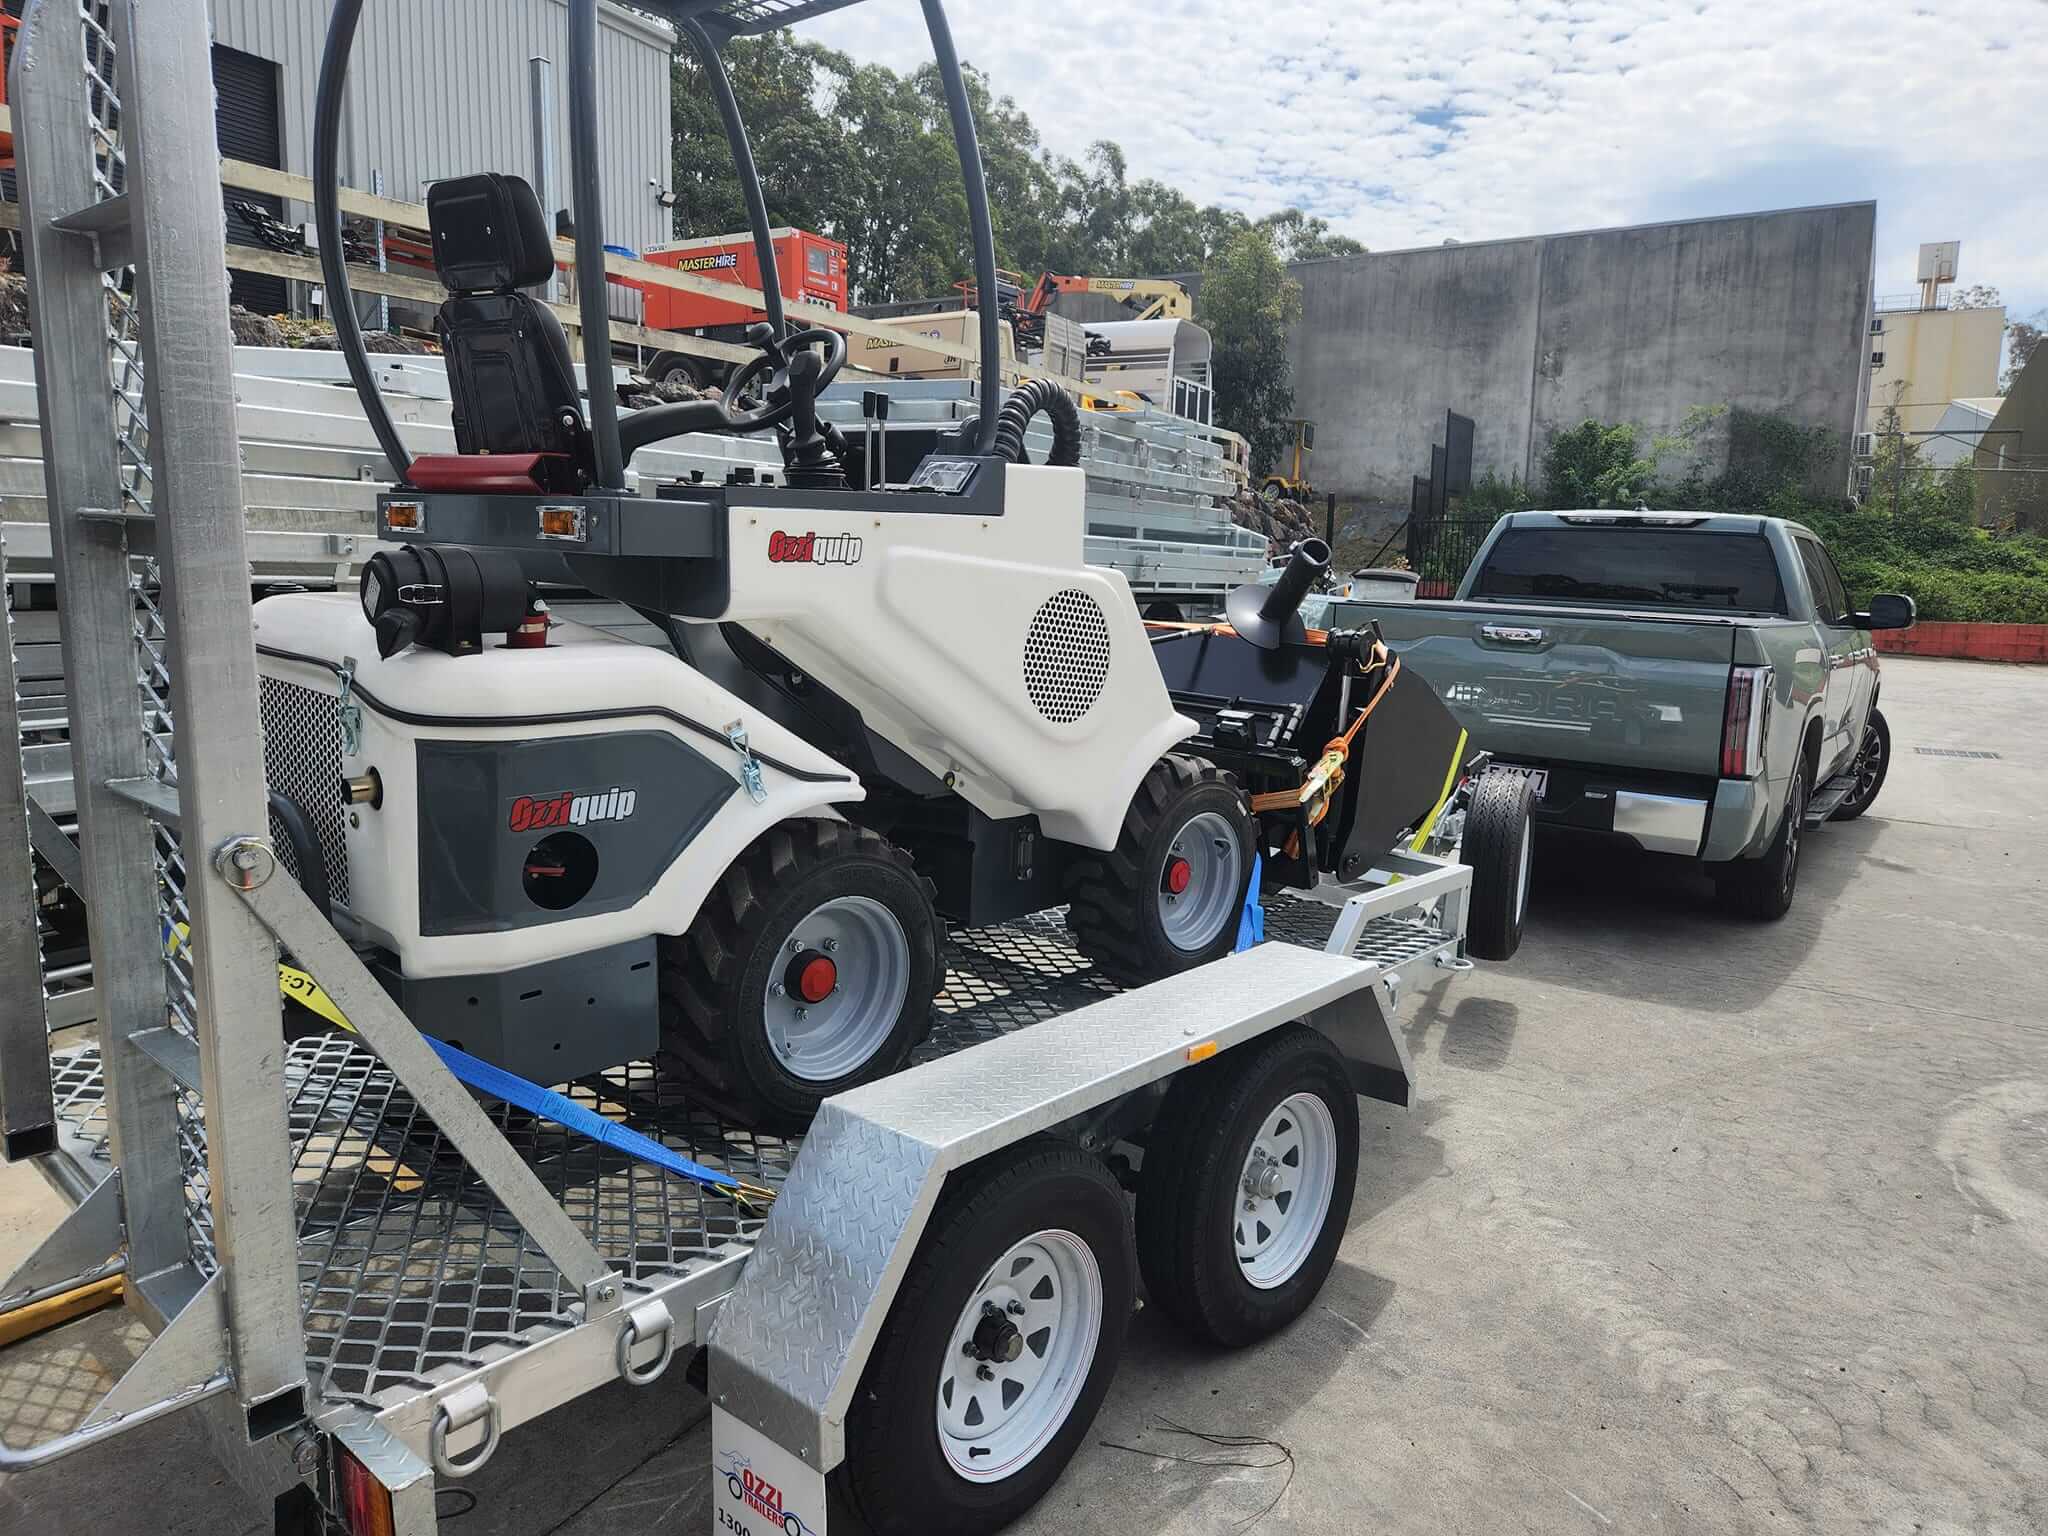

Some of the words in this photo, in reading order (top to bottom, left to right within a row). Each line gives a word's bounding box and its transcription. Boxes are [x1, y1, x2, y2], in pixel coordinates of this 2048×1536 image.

[678, 253, 737, 272] MASTERHIRE
[509, 786, 637, 833] Ozziquip
[743, 1468, 783, 1512] OZZI
[743, 1490, 785, 1530] TRAILERS
